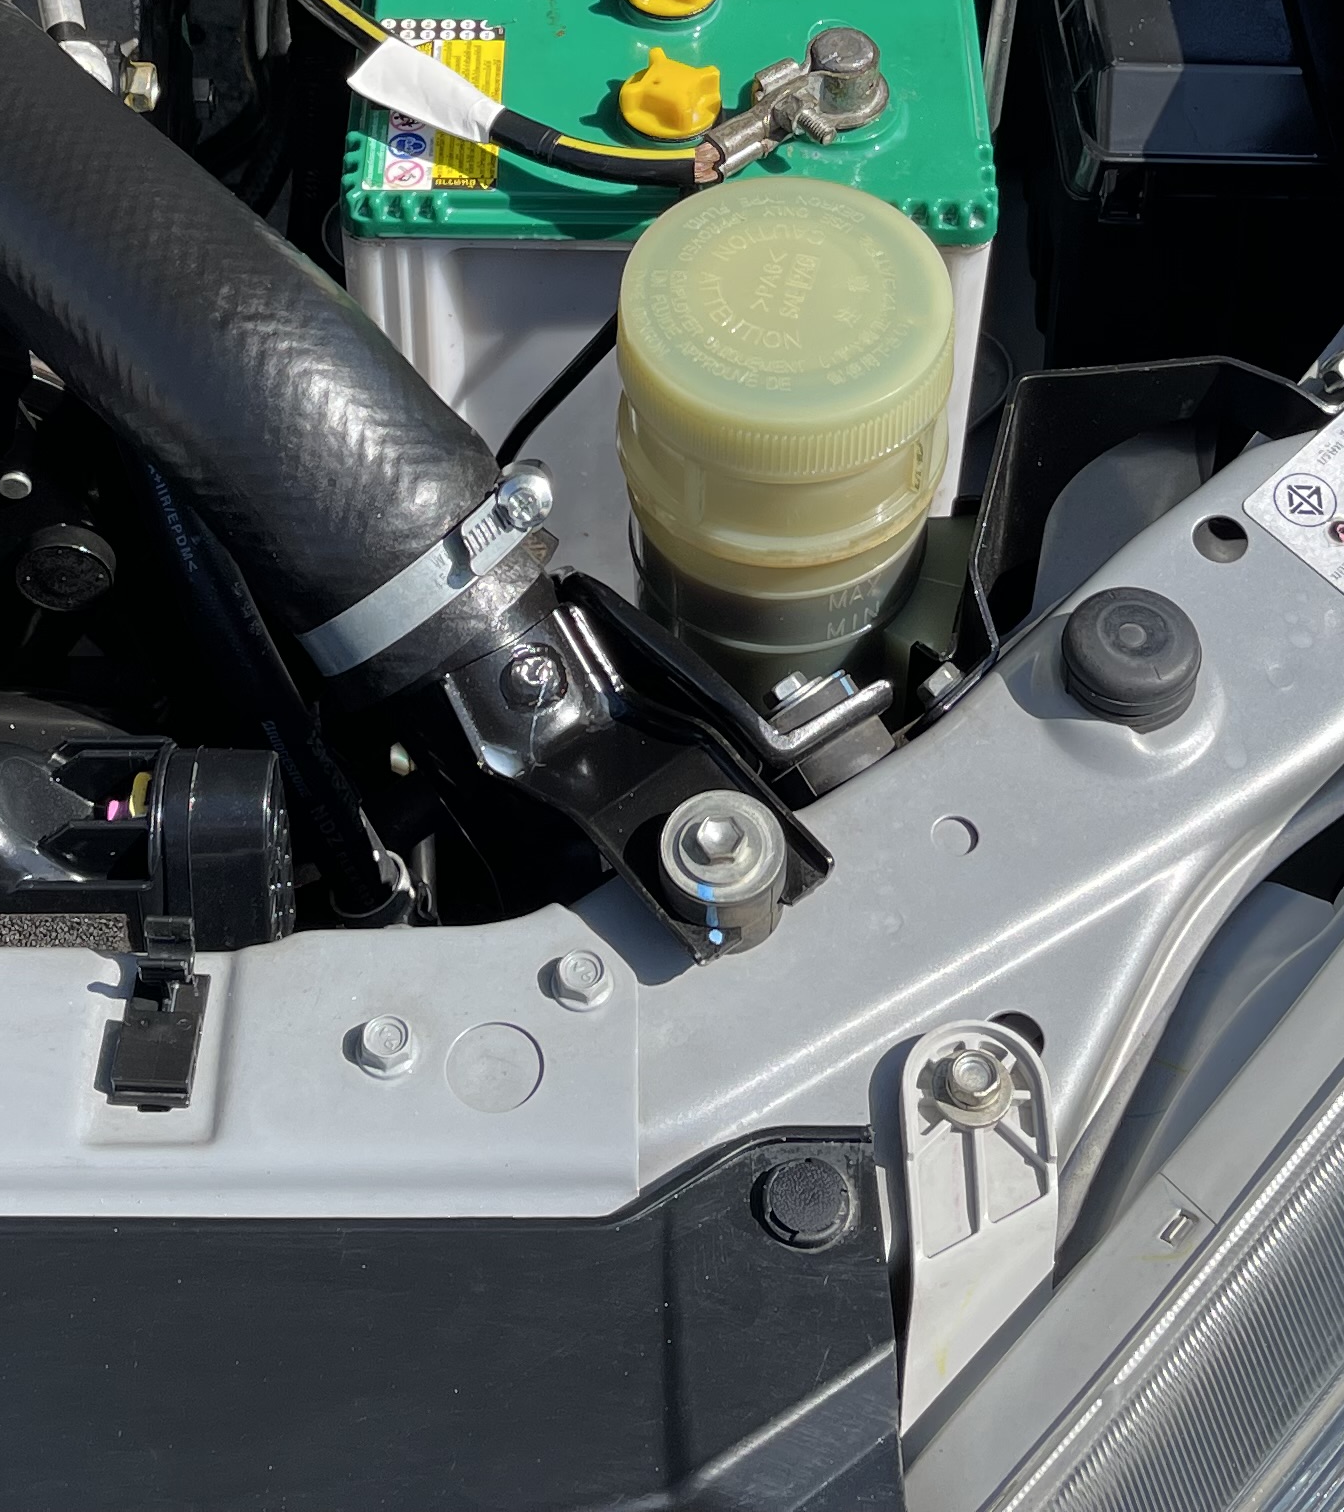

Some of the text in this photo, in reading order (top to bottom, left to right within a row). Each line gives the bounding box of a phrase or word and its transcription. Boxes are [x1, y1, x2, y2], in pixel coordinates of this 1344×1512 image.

[711, 224, 826, 262] CAUTION
[699, 272, 803, 350] ATTENTION
[828, 573, 882, 612] MAX
[826, 600, 880, 640] MIN
